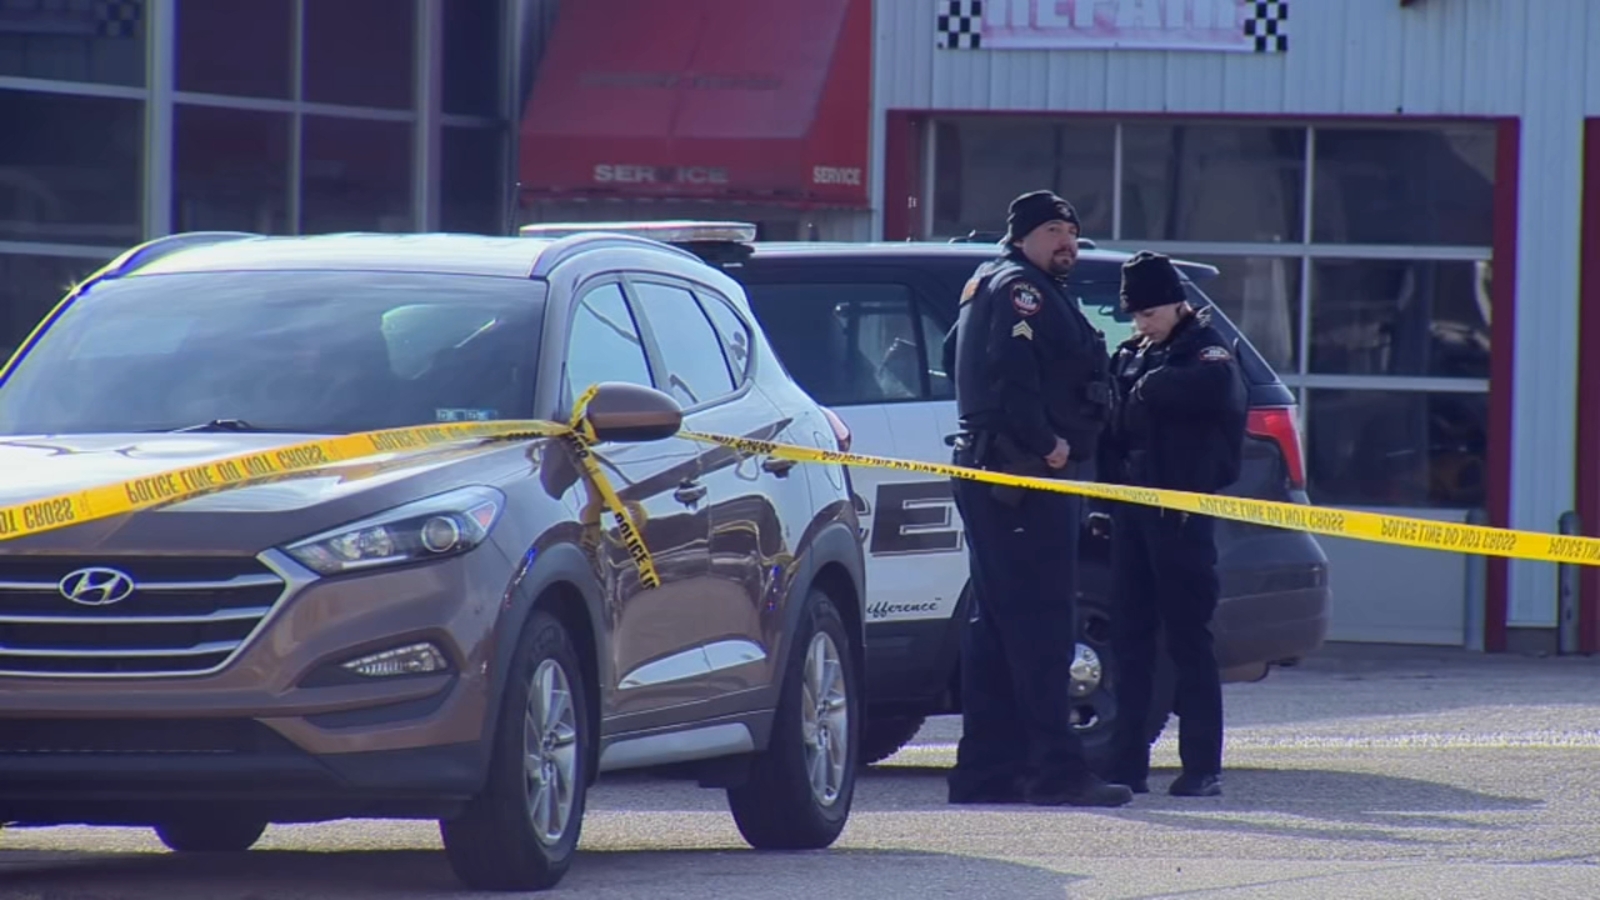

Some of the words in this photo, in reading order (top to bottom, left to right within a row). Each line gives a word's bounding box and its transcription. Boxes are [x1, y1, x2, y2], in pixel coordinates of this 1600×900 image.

[593, 164, 729, 184] SERVICE
[812, 166, 861, 185] SERVICE
[613, 512, 650, 566] POLICE
